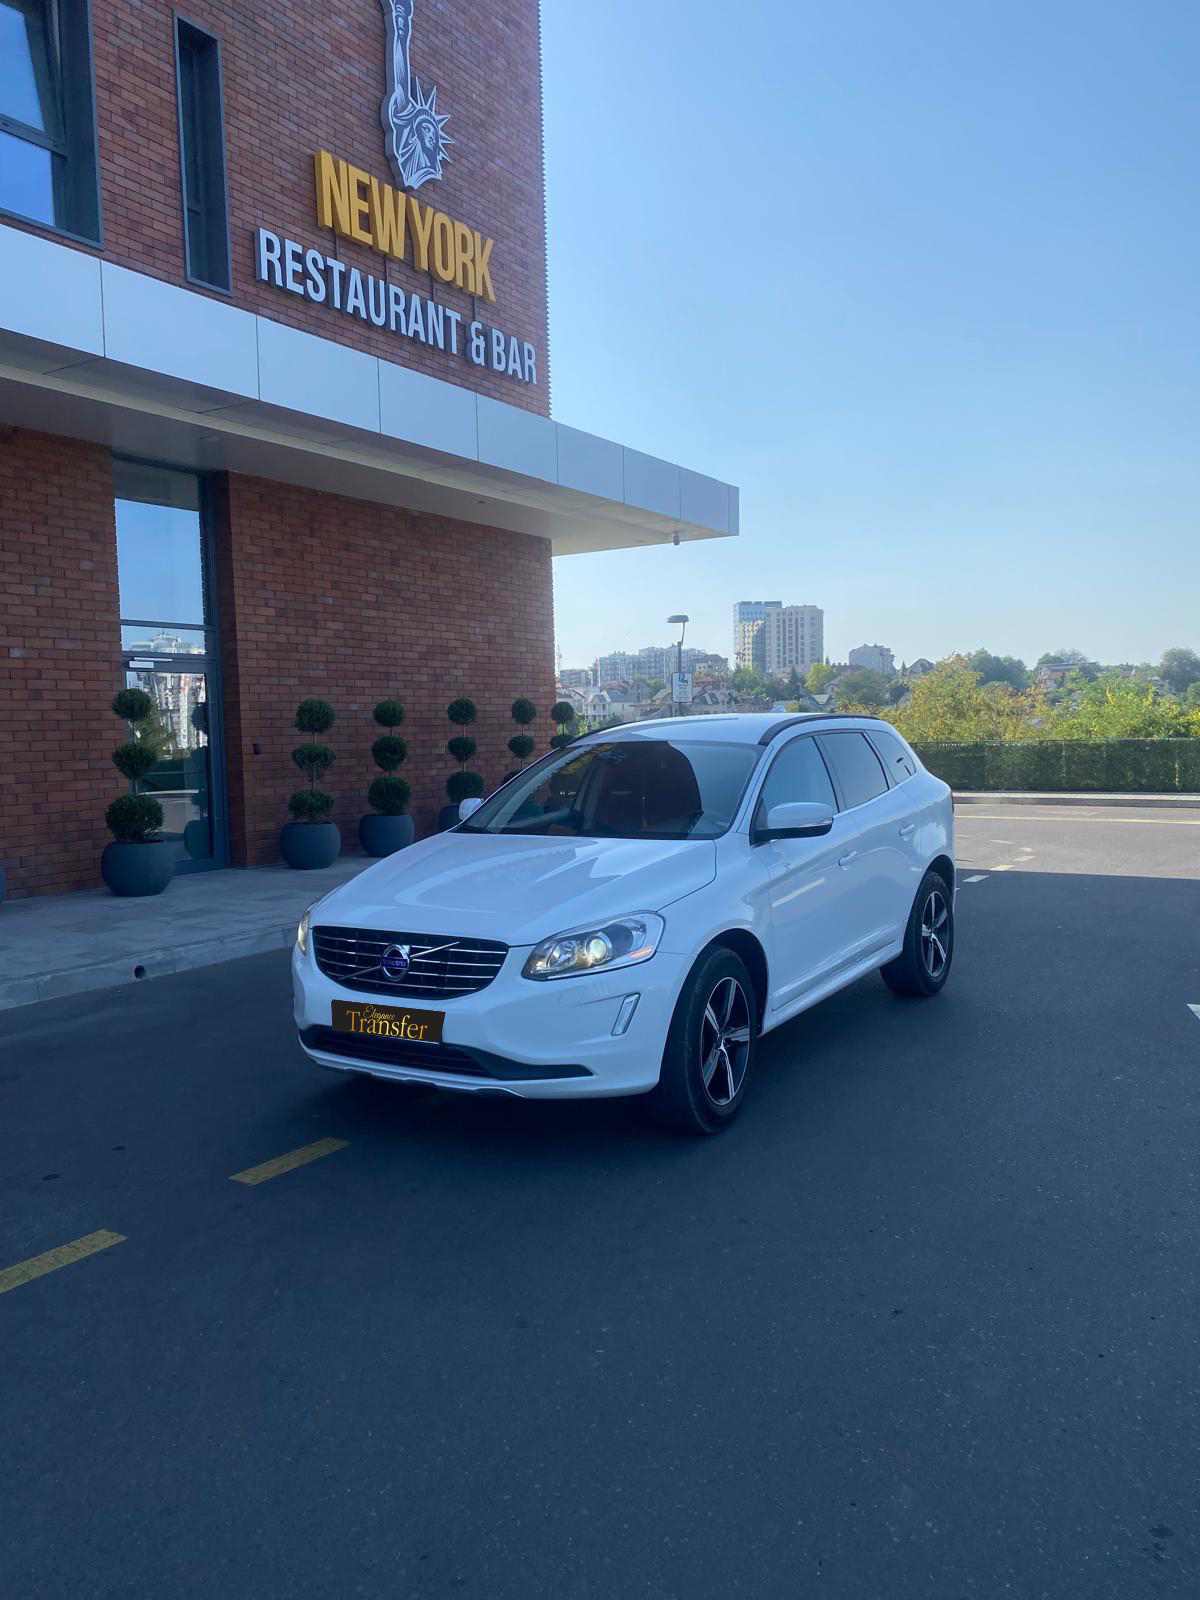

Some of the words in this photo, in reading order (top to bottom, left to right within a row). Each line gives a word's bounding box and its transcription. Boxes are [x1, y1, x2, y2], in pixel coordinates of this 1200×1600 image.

[314, 150, 406, 260] NEW
[410, 197, 496, 302] YORK
[257, 228, 462, 354] RESTAURANT
[470, 321, 486, 366] &
[492, 327, 538, 385] BAR
[346, 1009, 429, 1040] Transfer
